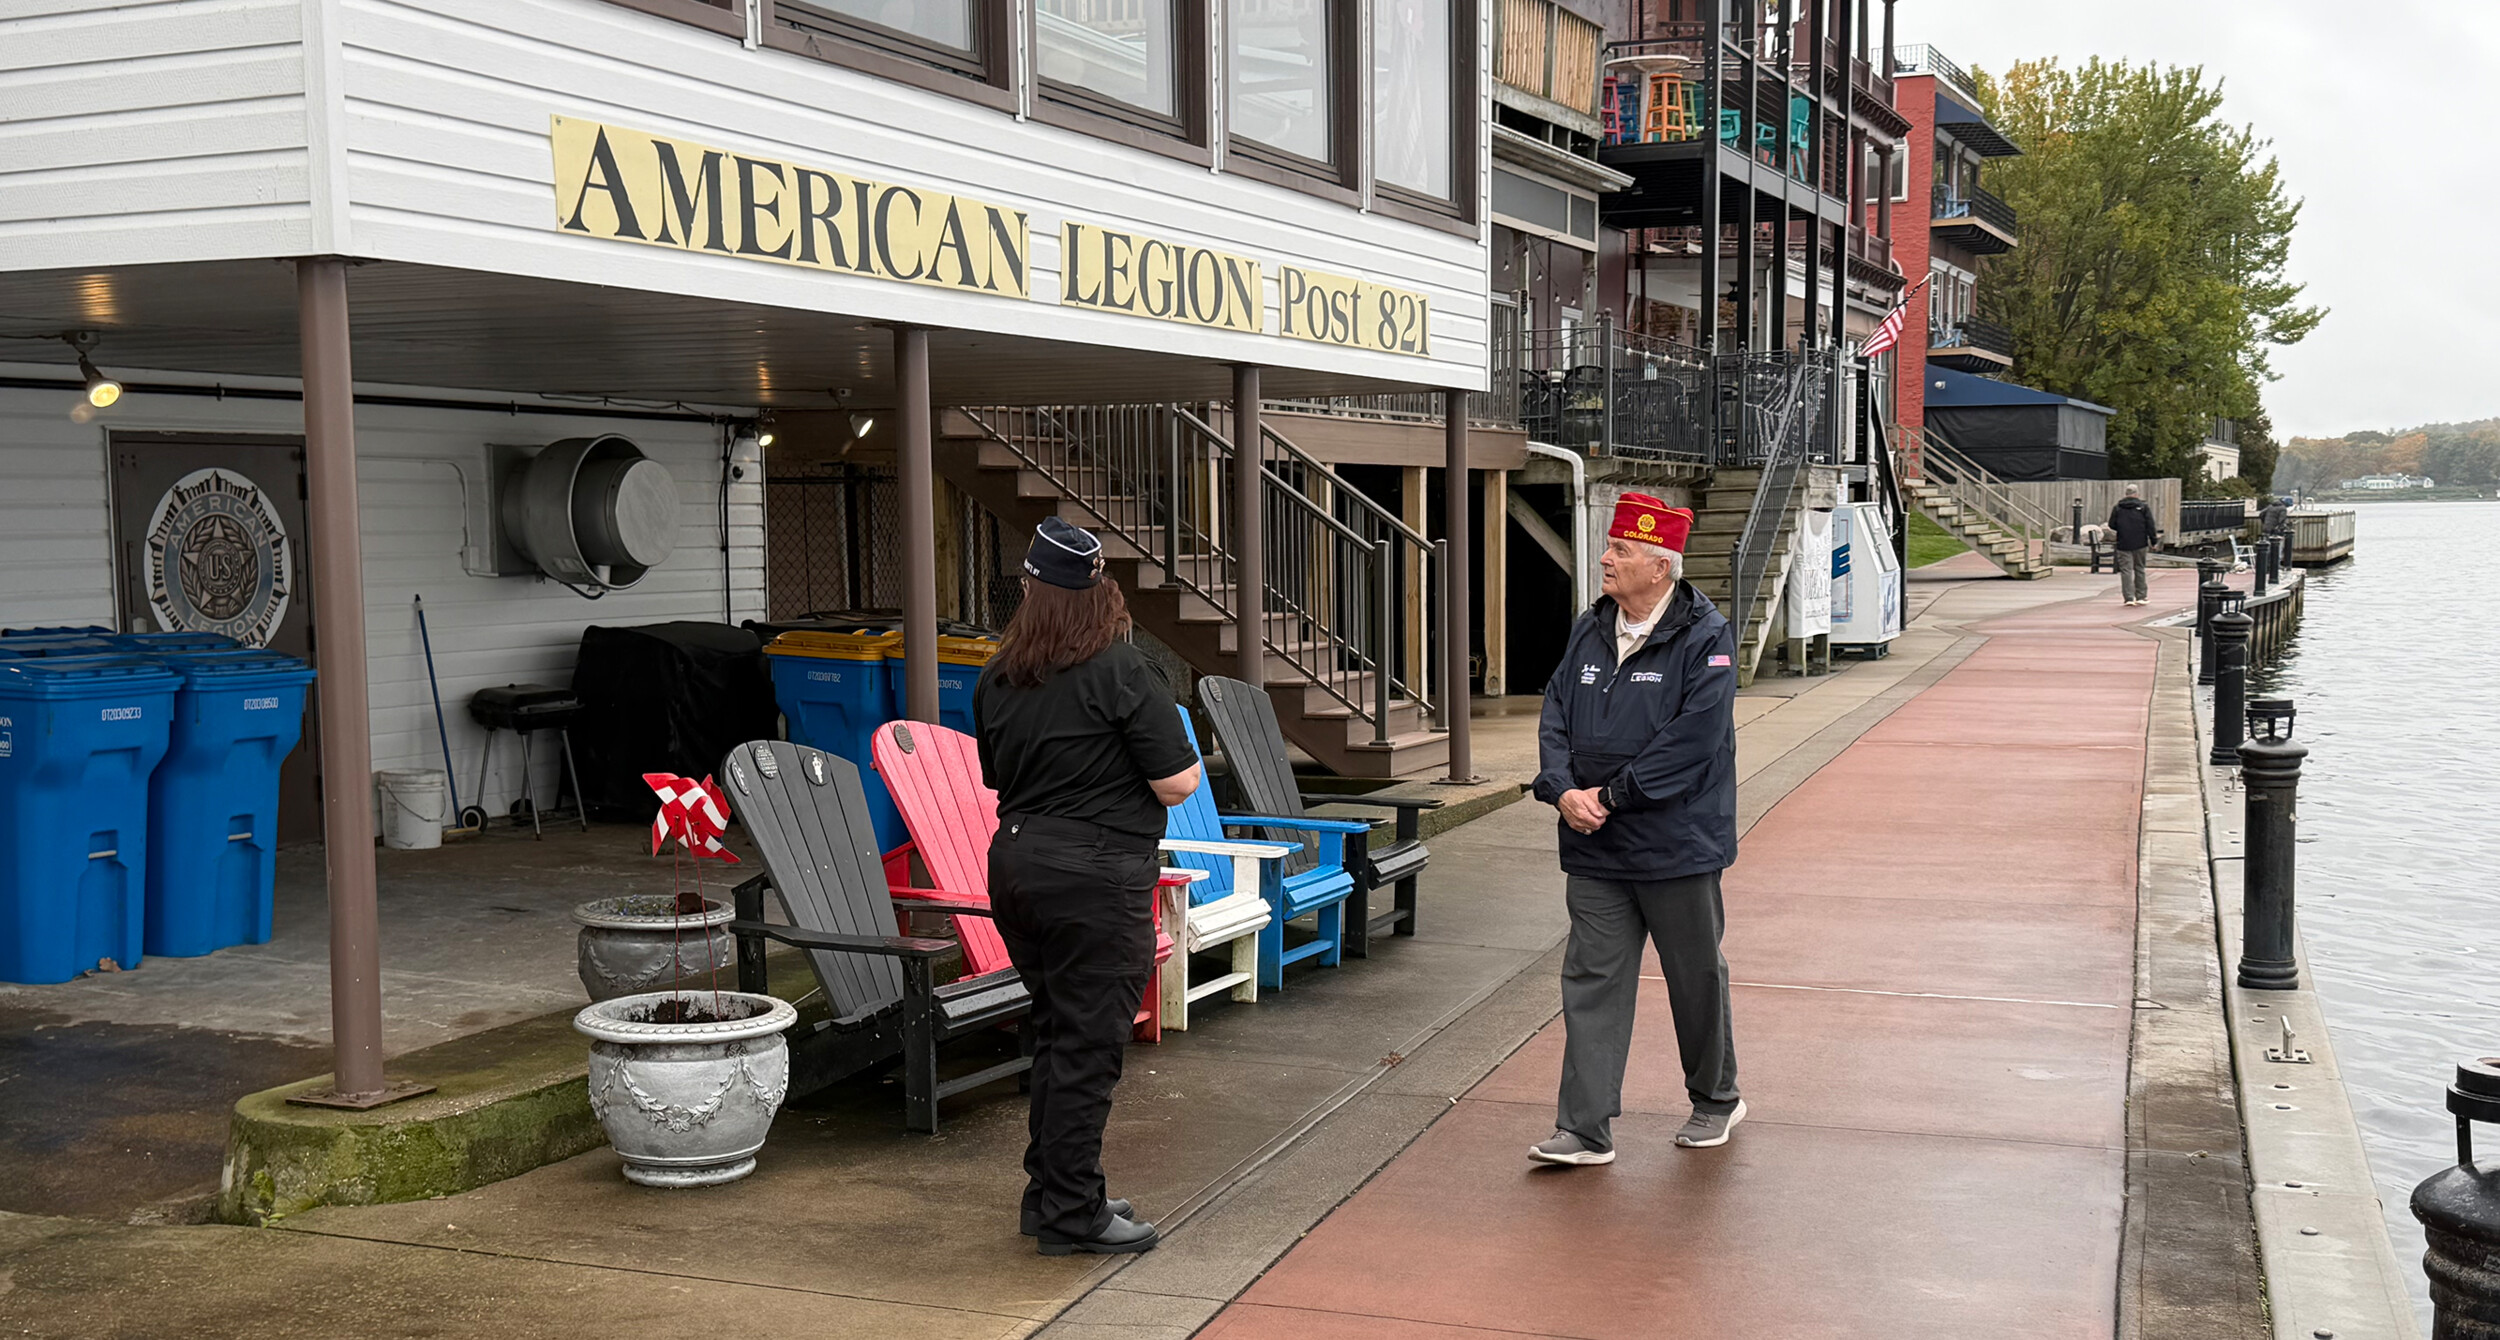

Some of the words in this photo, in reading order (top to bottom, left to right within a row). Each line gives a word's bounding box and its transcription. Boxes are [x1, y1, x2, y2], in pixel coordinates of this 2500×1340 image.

[564, 124, 1028, 297] AMERICAN
[1064, 222, 1255, 331] LEGION
[1282, 266, 1361, 345] Post
[1377, 289, 1430, 356] 821
[170, 495, 268, 550] AMERICAN
[1623, 530, 1664, 543] COLORADO
[187, 611, 258, 638] LEGION
[1630, 672, 1662, 683] LEGION
